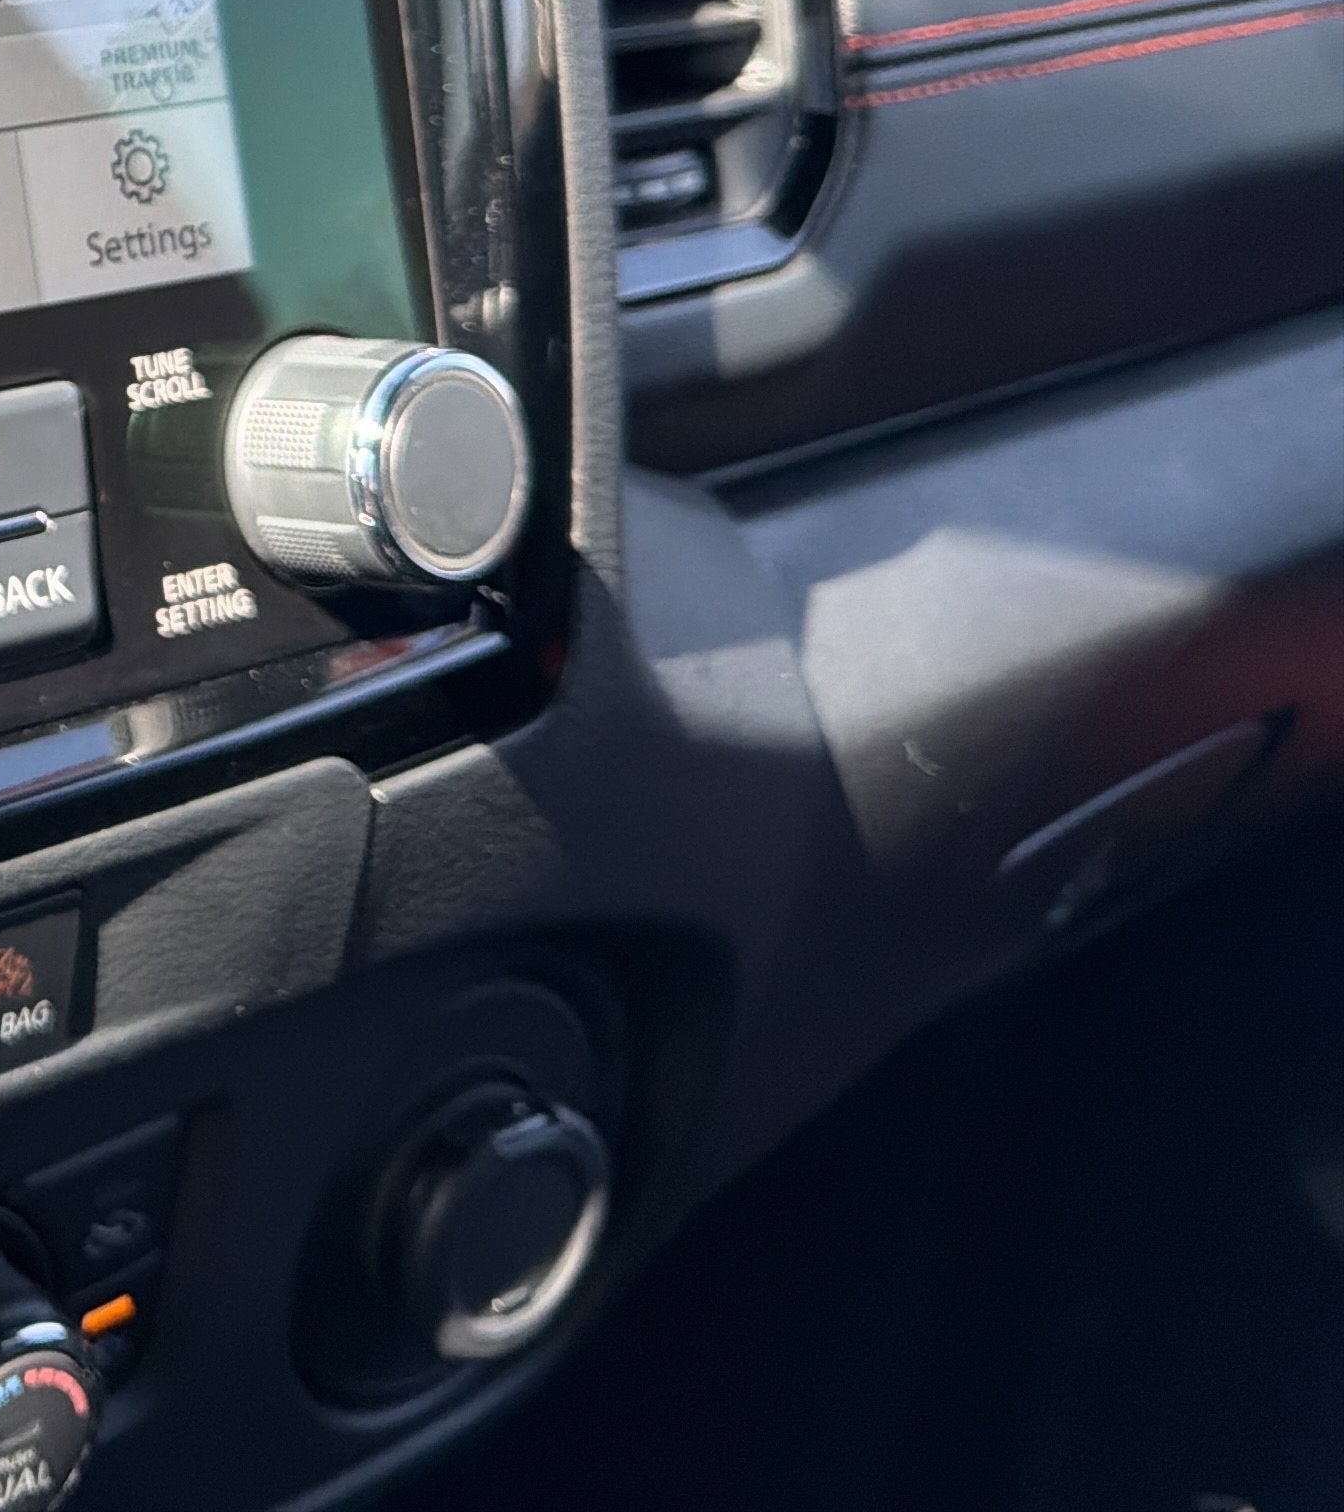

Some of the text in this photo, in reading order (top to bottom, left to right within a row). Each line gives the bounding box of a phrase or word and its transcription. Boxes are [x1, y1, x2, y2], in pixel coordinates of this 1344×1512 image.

[86, 221, 213, 268] Settings
[130, 348, 194, 381] TUNE
[127, 371, 212, 412] SCROLL
[162, 563, 239, 604] ENTER
[155, 588, 259, 638] SETTING
[0, 999, 55, 1045] BAG
